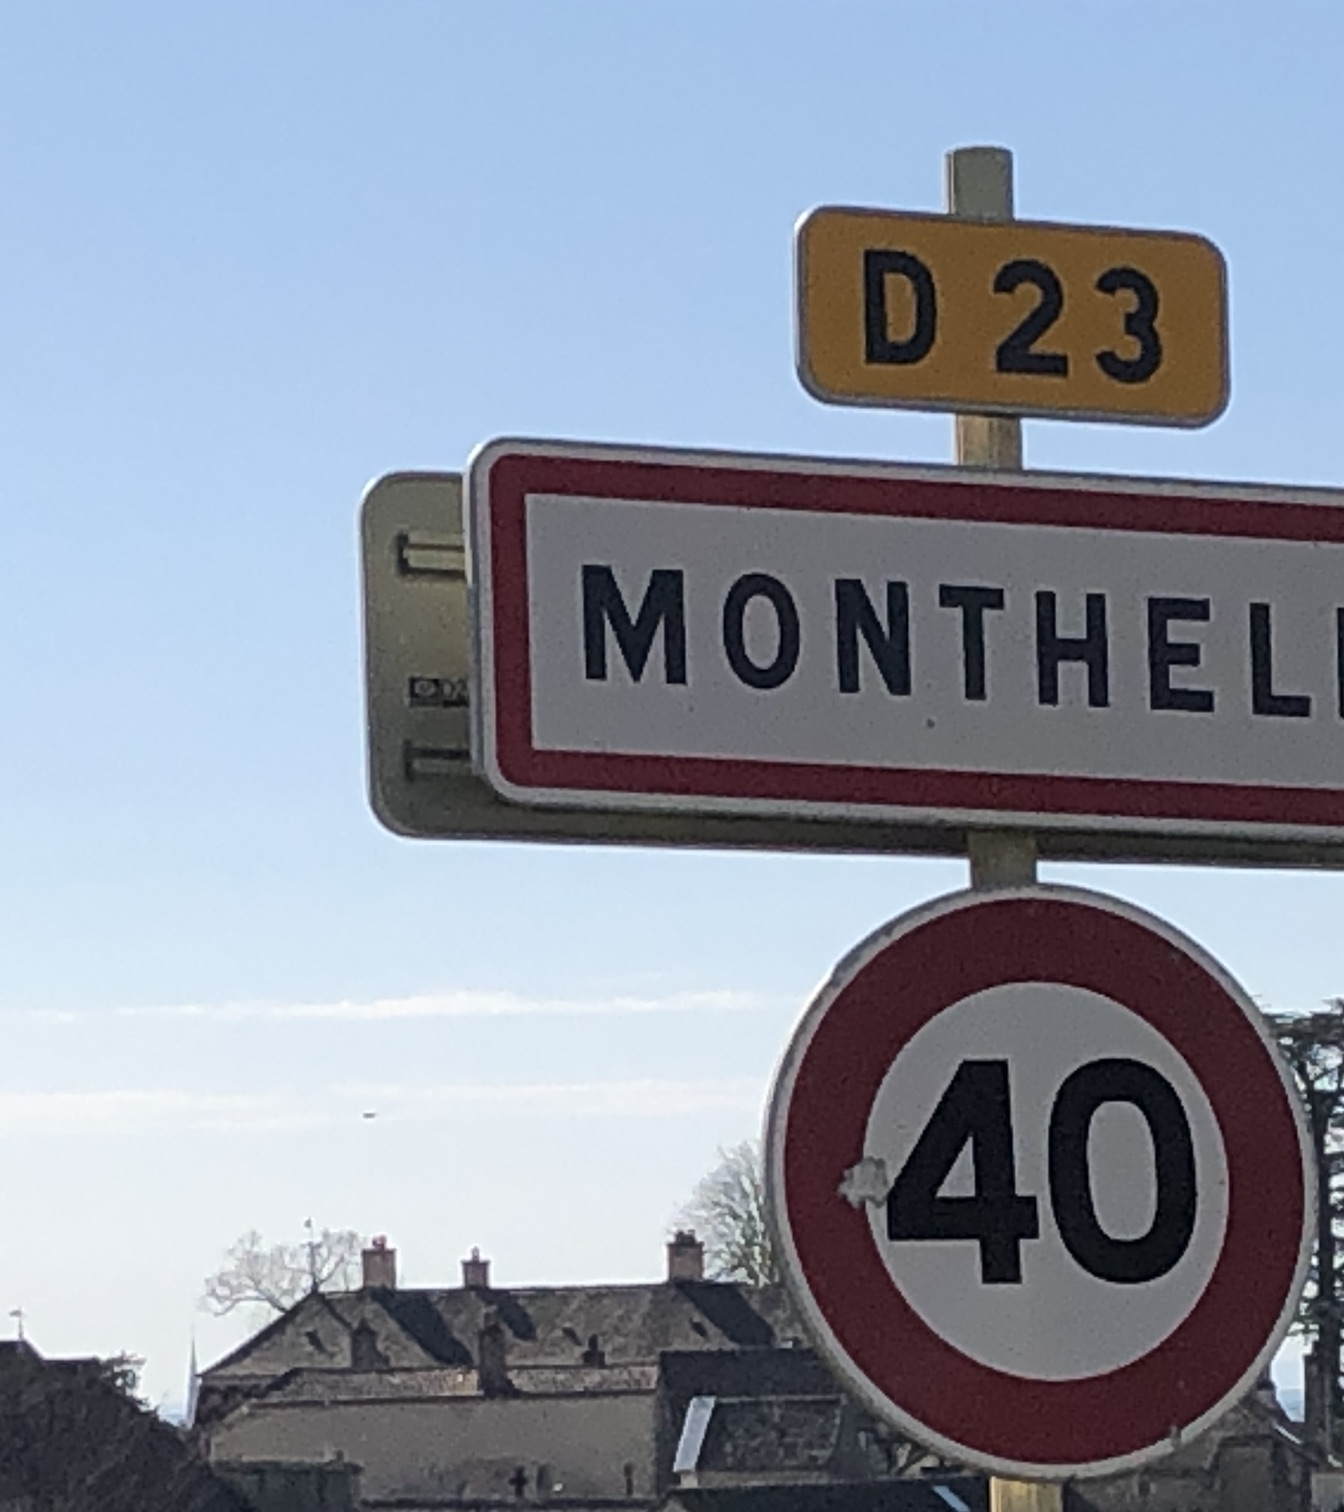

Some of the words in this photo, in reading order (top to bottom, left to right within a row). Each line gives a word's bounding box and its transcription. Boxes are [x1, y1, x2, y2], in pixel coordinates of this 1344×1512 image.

[863, 248, 938, 366] D
[993, 258, 1163, 384] 23
[886, 1057, 1198, 1285] 40
